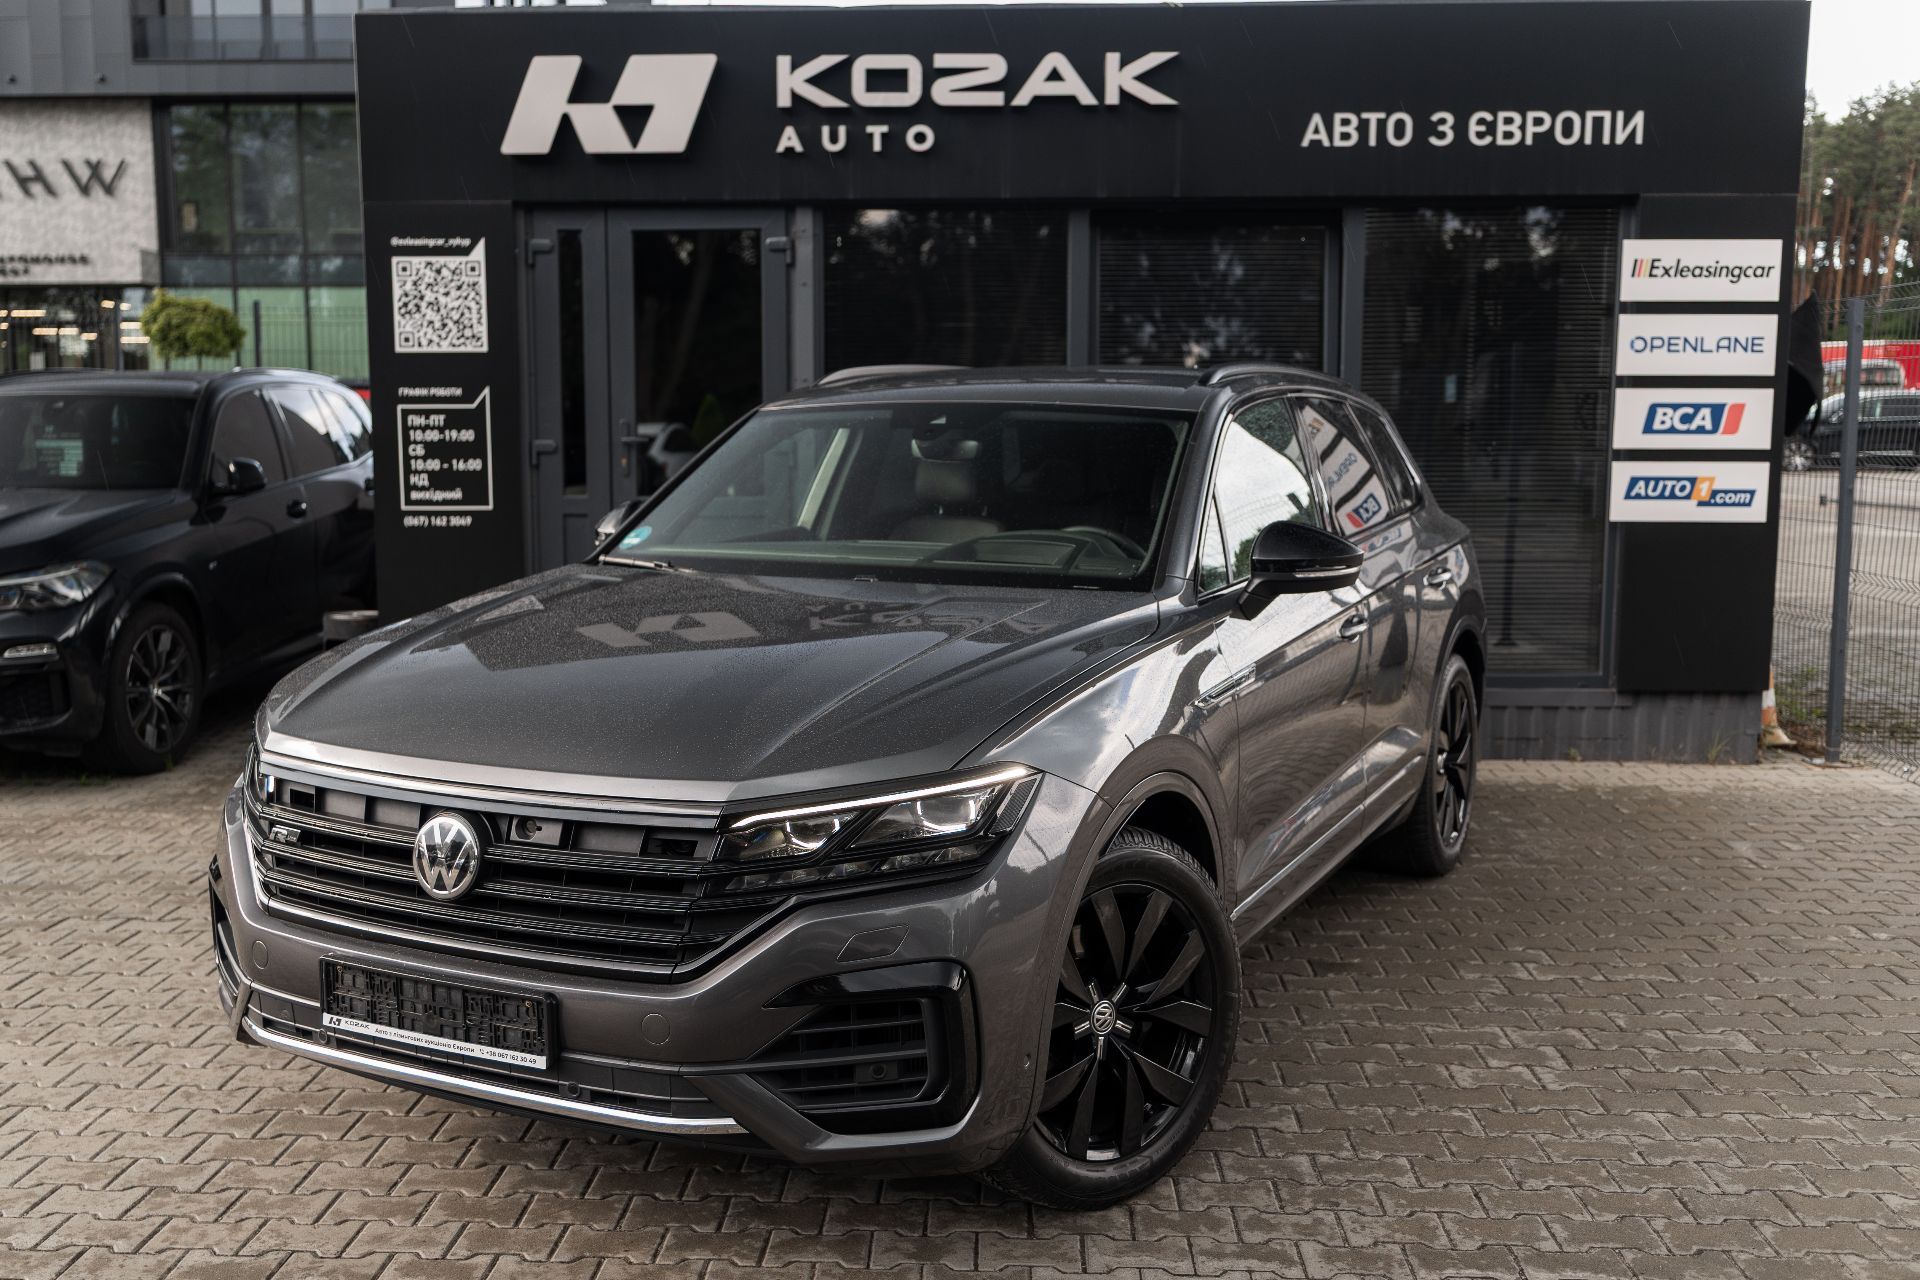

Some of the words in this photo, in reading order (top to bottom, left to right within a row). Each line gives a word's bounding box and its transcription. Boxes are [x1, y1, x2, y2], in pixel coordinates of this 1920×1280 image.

[776, 52, 1180, 108] KOZAK
[776, 124, 935, 153] AUTO
[1300, 111, 1414, 147] АВТО
[1427, 110, 1456, 147] З
[1467, 110, 1646, 147] ЄВРОПИ
[0, 158, 126, 198] HW
[1649, 258, 1775, 284] Exleasingcar
[1630, 336, 1765, 353] OPENLANE
[407, 414, 446, 428] ПН-ПТ
[1652, 406, 1713, 431] BCA
[409, 429, 475, 442] 10:00-19:00
[408, 443, 425, 457] СБ
[410, 458, 441, 471] 10:00
[452, 458, 482, 471] 16:00
[410, 472, 430, 488] НД
